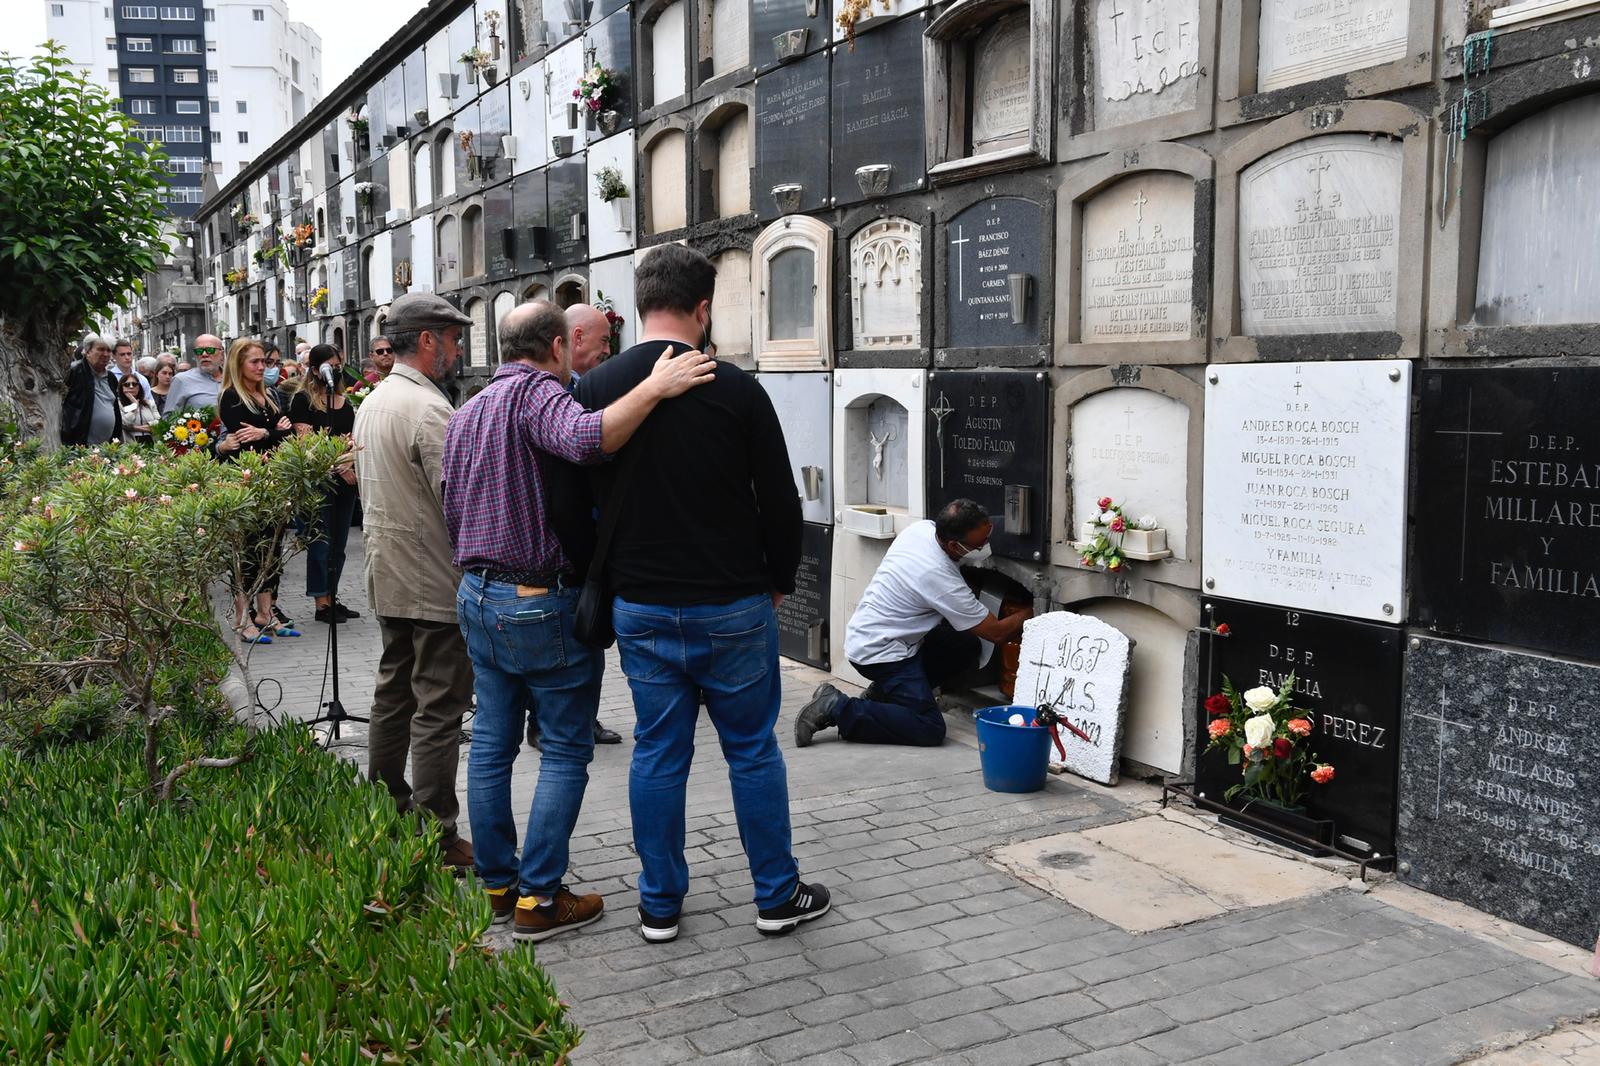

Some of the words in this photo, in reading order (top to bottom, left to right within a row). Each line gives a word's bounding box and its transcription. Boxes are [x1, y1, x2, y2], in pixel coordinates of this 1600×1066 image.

[846, 115, 879, 134] RAMIREZ
[881, 106, 910, 125] GARCIA
[978, 231, 1009, 243] FRANCISCO
[1161, 236, 1193, 253] CASTILL
[982, 278, 1006, 288] CARMEN
[968, 295, 995, 306] QUINTANA
[1552, 371, 1559, 382] 7
[1241, 419, 1285, 432] ANDRES
[1286, 420, 1317, 433] ROCA
[1321, 421, 1360, 434] BOSCH
[952, 434, 982, 450] TOLEDO
[1241, 451, 1281, 465] MIGUEL
[1284, 453, 1314, 466] ROCA
[1318, 454, 1356, 468] BOSCH
[976, 475, 1003, 486] SOBRINOS
[1245, 483, 1276, 496] JUAN
[1278, 484, 1308, 498] ROCA
[1312, 487, 1350, 501] BOSCH
[1484, 495, 1600, 528] MILLARE
[1241, 513, 1280, 527] MIGUEL
[1283, 516, 1313, 530] ROCA
[1317, 519, 1366, 536] SEGURA
[1540, 536, 1555, 555] Y
[1267, 548, 1275, 560] Y
[1277, 549, 1322, 566] FAMILIA
[1280, 564, 1323, 581] CABRERA
[1489, 561, 1600, 599] FAMILIA
[1286, 611, 1300, 626] 12
[1532, 667, 1540, 679] 8
[1258, 668, 1323, 699] FAMLIA
[1322, 714, 1387, 749] PEREZ
[1495, 726, 1570, 756] ANDREA
[1488, 751, 1576, 789] MILLARES
[1476, 779, 1584, 824] FERNANDEZ
[1482, 836, 1491, 854] Y
[1498, 843, 1574, 881] FAMILIA
